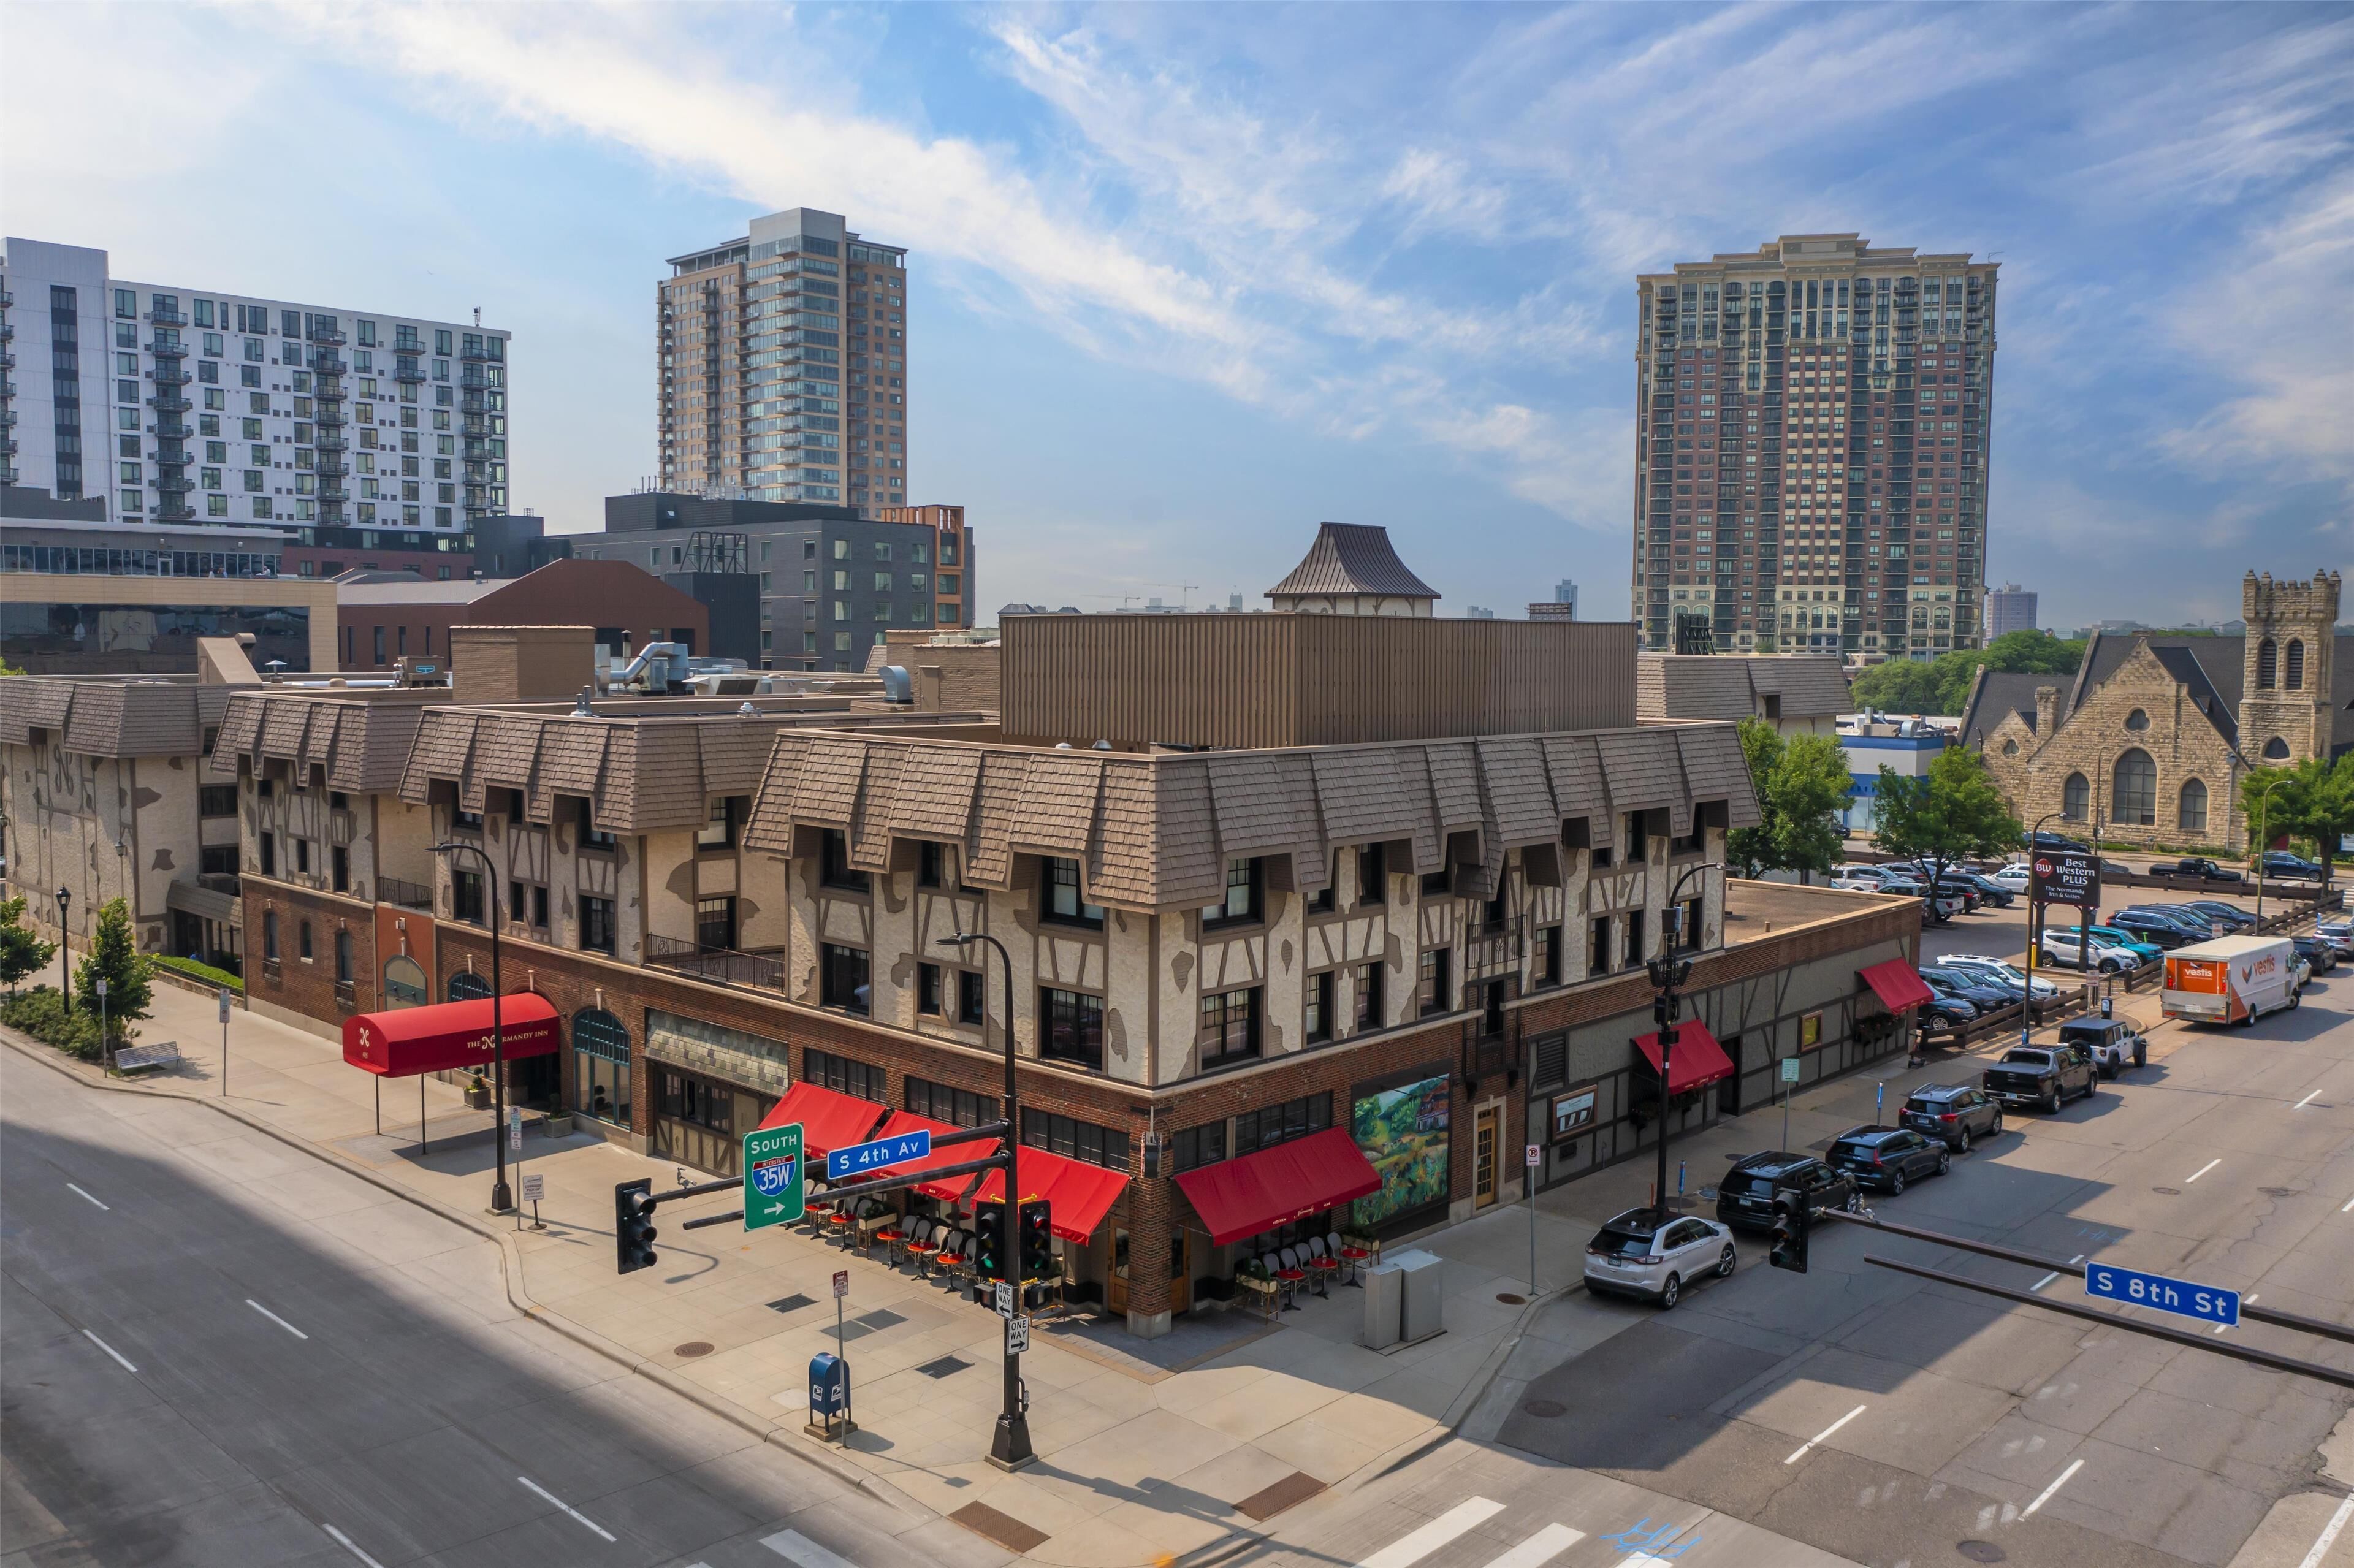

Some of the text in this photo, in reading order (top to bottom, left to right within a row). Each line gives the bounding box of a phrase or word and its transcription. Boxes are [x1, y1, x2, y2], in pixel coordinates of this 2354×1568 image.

[2036, 864, 2051, 872] BW
[2066, 858, 2087, 867] Best
[2056, 866, 2095, 876] Western
[2063, 875, 2088, 885] PLUS
[2253, 954, 2275, 976] vestis
[2184, 969, 2212, 977] vestis
[481, 1032, 533, 1049] NRMANDY
[751, 1134, 797, 1154] SOUTH
[840, 1141, 919, 1170] S 4th Av
[762, 1157, 786, 1168] INTERSTATE
[759, 1165, 790, 1192] 35W
[998, 1284, 1010, 1296] ONE
[2098, 1273, 2226, 1317] S 8th St
[998, 1293, 1011, 1305] WAY
[1011, 1320, 1026, 1330] ONE
[1010, 1329, 1026, 1340] WAY
